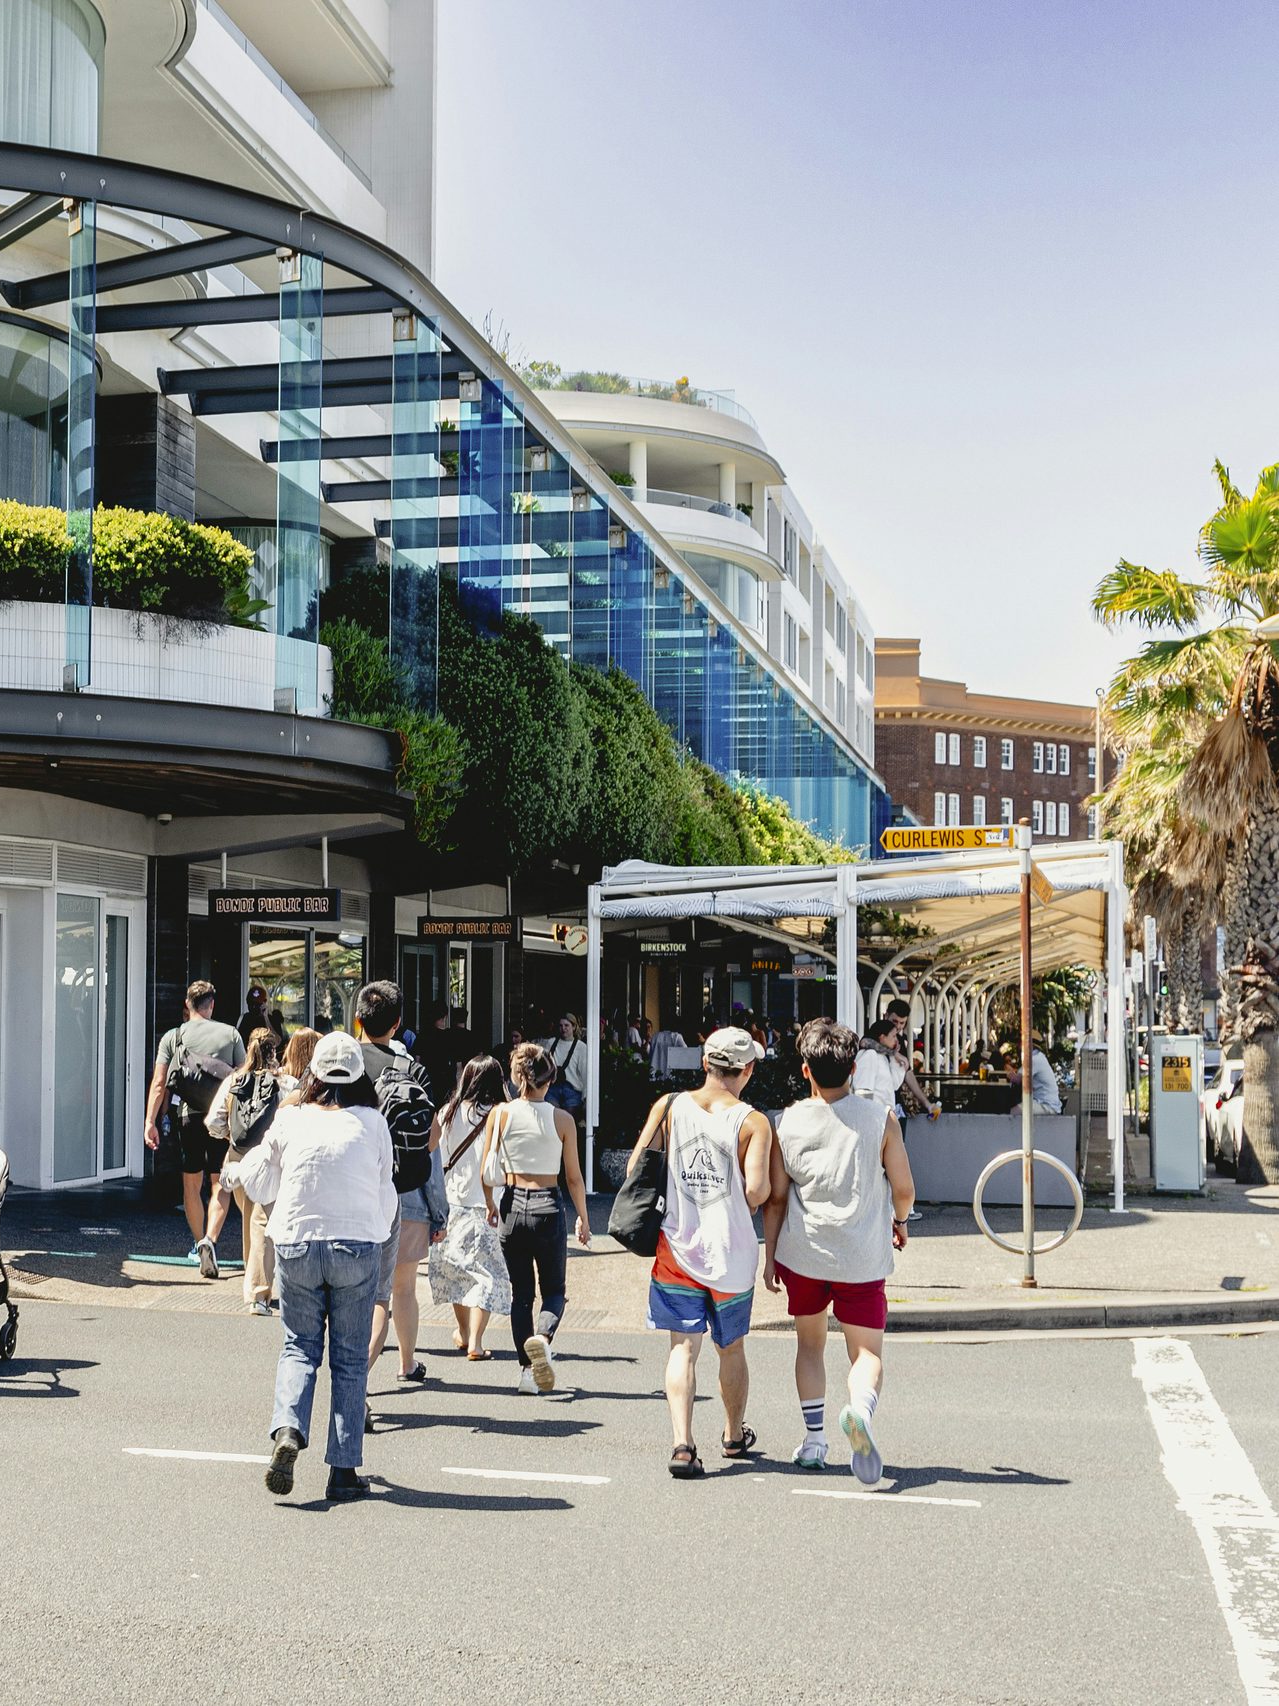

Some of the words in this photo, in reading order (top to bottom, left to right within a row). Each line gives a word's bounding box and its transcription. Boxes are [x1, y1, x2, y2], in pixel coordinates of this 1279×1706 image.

[892, 829, 965, 848] CURLEWIS
[215, 897, 255, 913] BONDI
[258, 897, 301, 913] PUBLIC
[303, 897, 329, 913] BAR
[423, 922, 454, 935] BONDI
[456, 922, 489, 935] PUBLIC
[491, 922, 512, 935] BAR
[640, 943, 687, 952] BIRKENSTOCK
[1164, 1055, 1189, 1067] 2315
